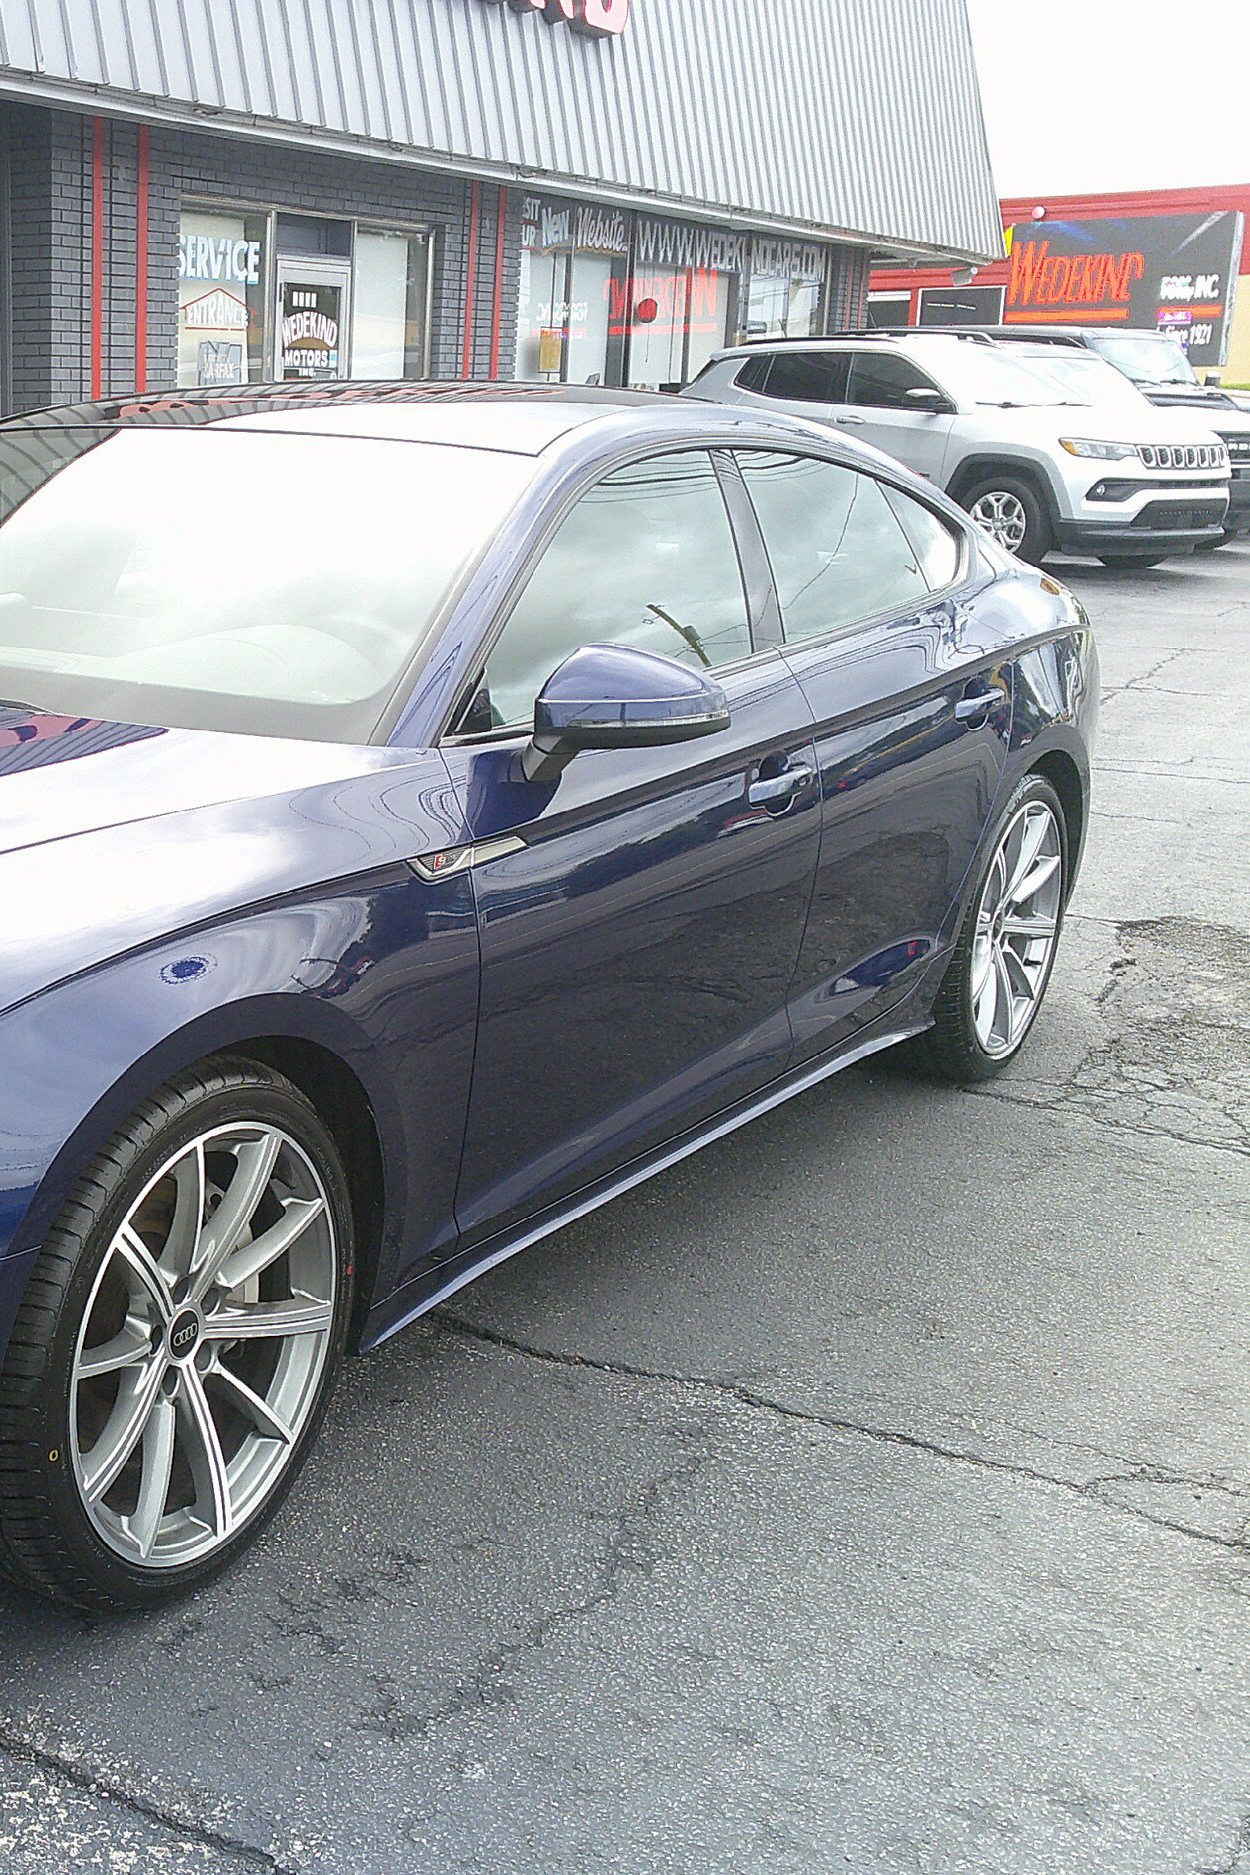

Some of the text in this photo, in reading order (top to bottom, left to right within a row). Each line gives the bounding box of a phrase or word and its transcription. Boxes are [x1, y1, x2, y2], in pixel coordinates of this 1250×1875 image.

[522, 197, 541, 220] SIT
[521, 224, 536, 247] UR
[542, 206, 570, 248] New
[179, 235, 261, 285] SERVICE
[187, 295, 249, 327] ENTRANCE
[282, 311, 338, 348] WEDEKIND
[285, 349, 328, 367] MOTORS
